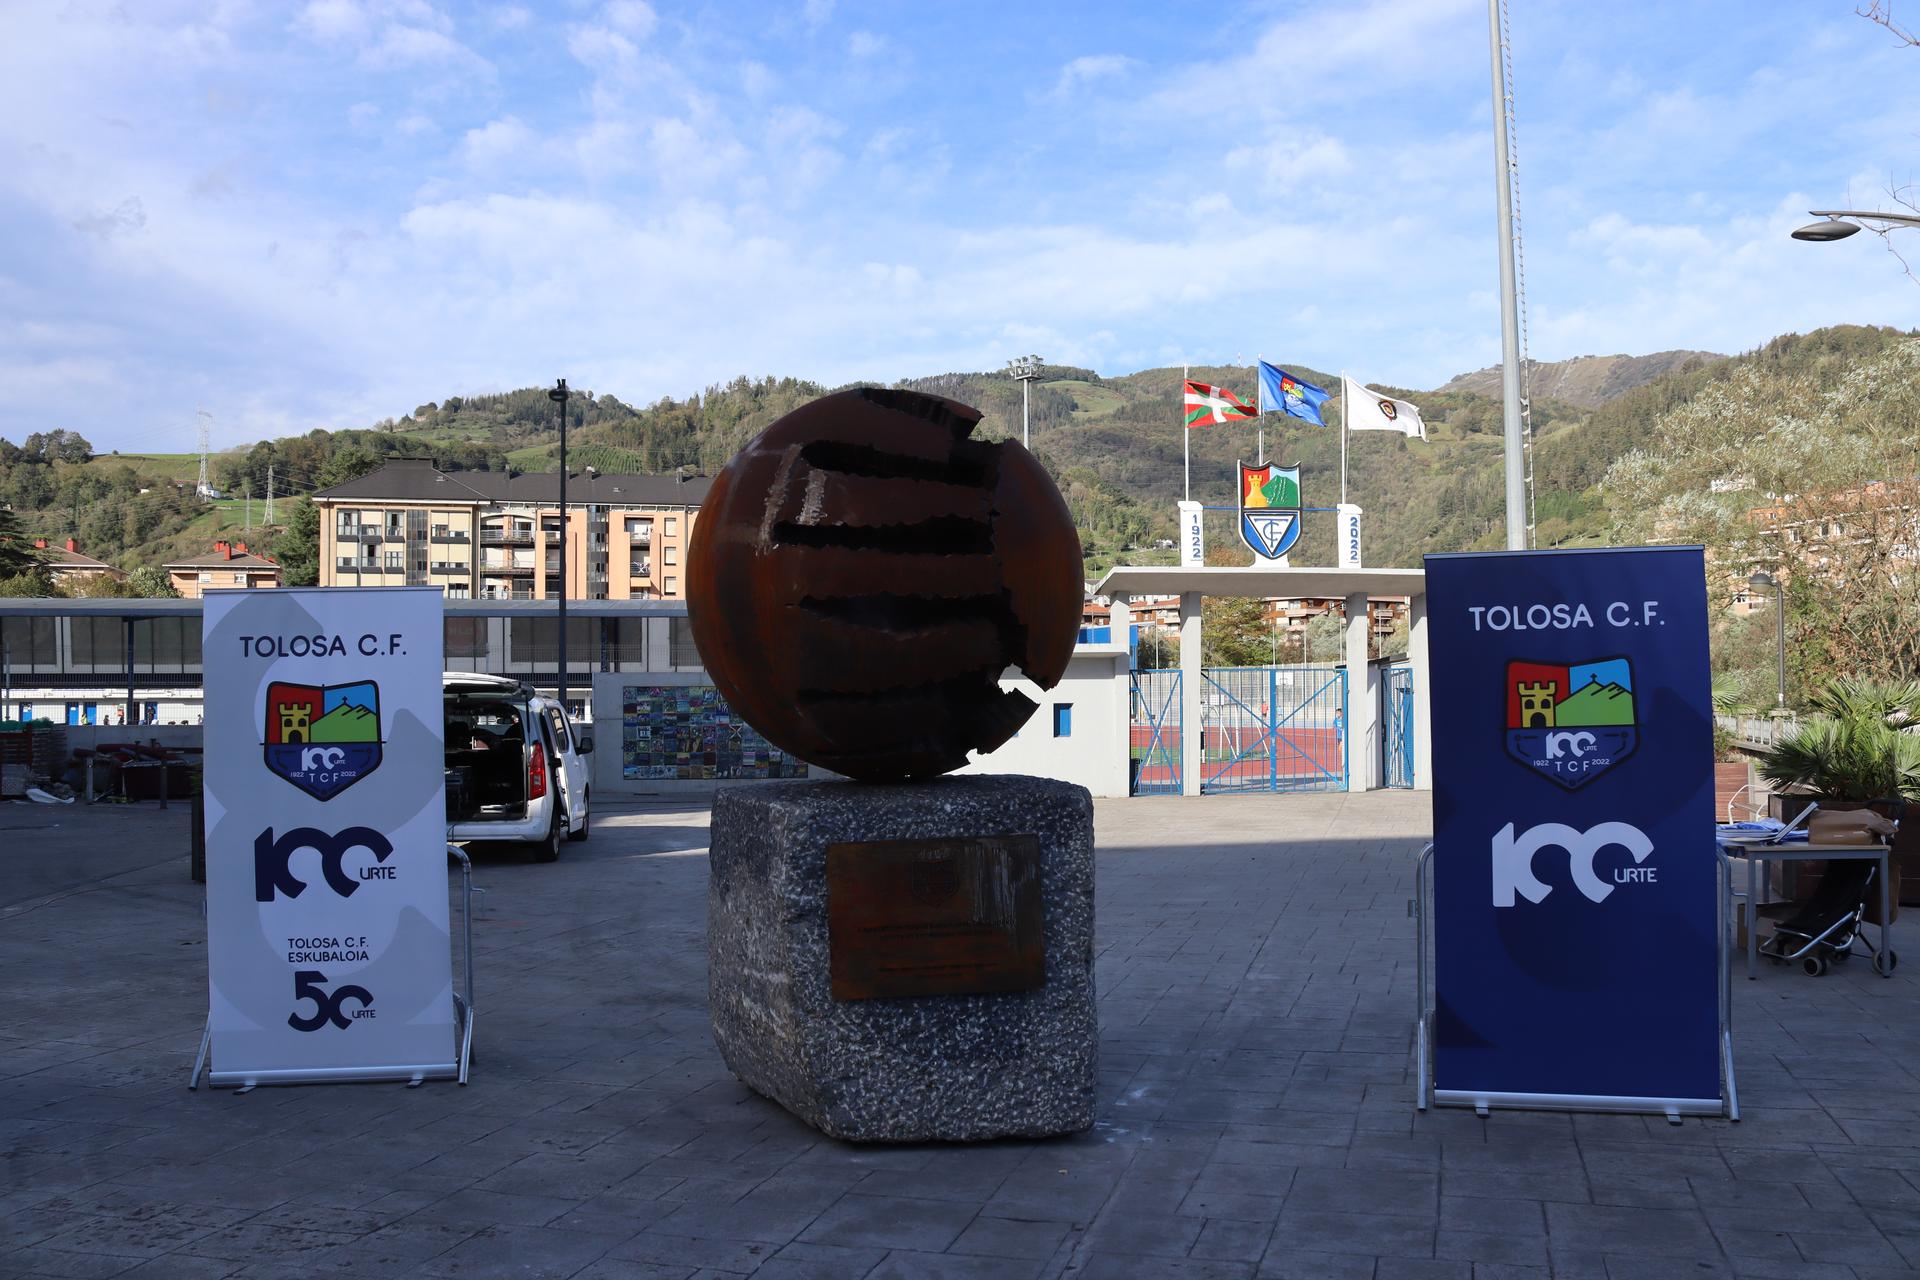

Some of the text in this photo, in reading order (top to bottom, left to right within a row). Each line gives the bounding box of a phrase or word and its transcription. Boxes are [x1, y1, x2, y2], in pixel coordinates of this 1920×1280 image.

[1191, 513, 1201, 559] 1922
[1350, 516, 1359, 561] 2022
[1468, 601, 1665, 631] TOLOSA C.F.
[239, 633, 408, 658] TOLOSA C.F.
[1533, 759, 1550, 767] 1922
[1591, 758, 1610, 766] 2022
[340, 770, 357, 778] 2022
[359, 866, 397, 880] URTE
[1614, 867, 1658, 883] URTE
[287, 936, 370, 949] TOLOSA C.F.
[288, 950, 370, 963] ESKUBALOIA
[287, 970, 377, 1032] 50 URTE
